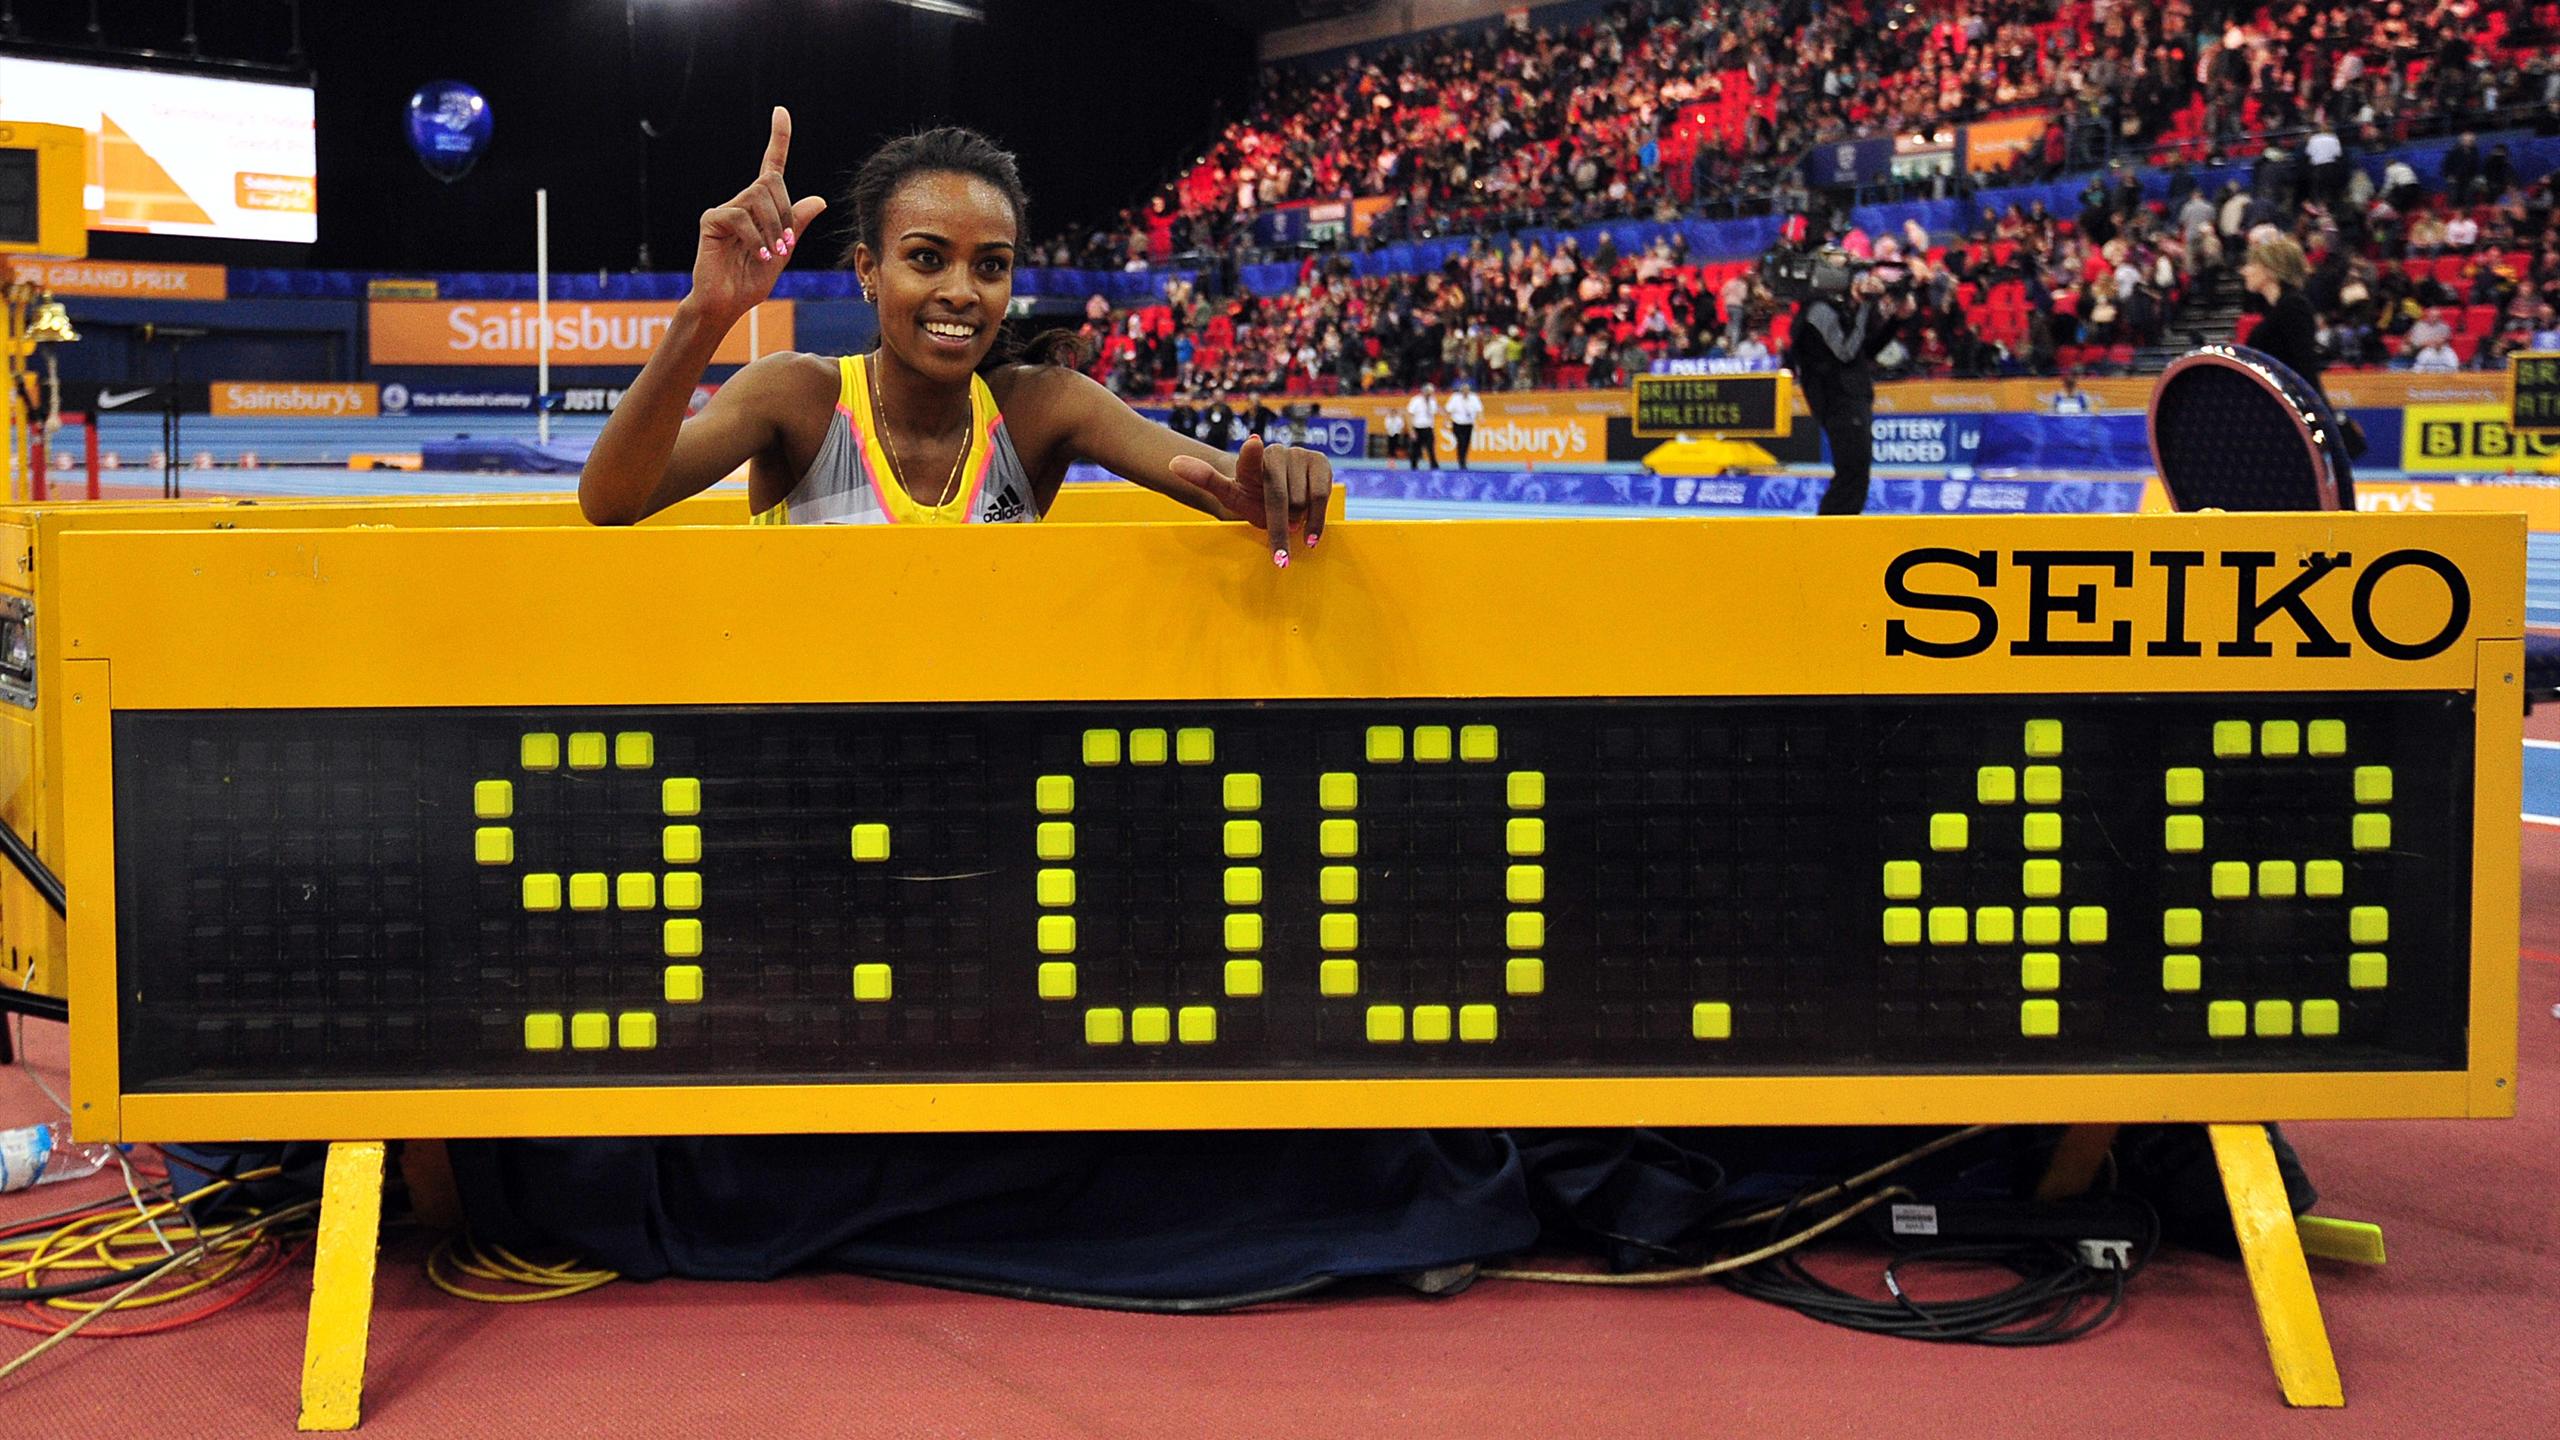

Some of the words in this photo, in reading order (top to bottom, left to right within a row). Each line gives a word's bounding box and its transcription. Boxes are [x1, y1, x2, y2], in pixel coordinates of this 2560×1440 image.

[48, 268, 129, 289] GRAND
[132, 271, 189, 290] PRIX
[448, 306, 673, 350] Sainsbur
[226, 386, 363, 414] Sainsbury's
[563, 389, 605, 410] JUST
[1641, 382, 1719, 401] BRITISH
[1641, 403, 1741, 424] ATHLETICS
[1439, 419, 1588, 458] Sinsbury's
[1871, 418, 1946, 440] OTTERY
[1871, 440, 1947, 462] UNDED
[983, 504, 1024, 523] adidas
[1884, 547, 2471, 661] SEIKO
